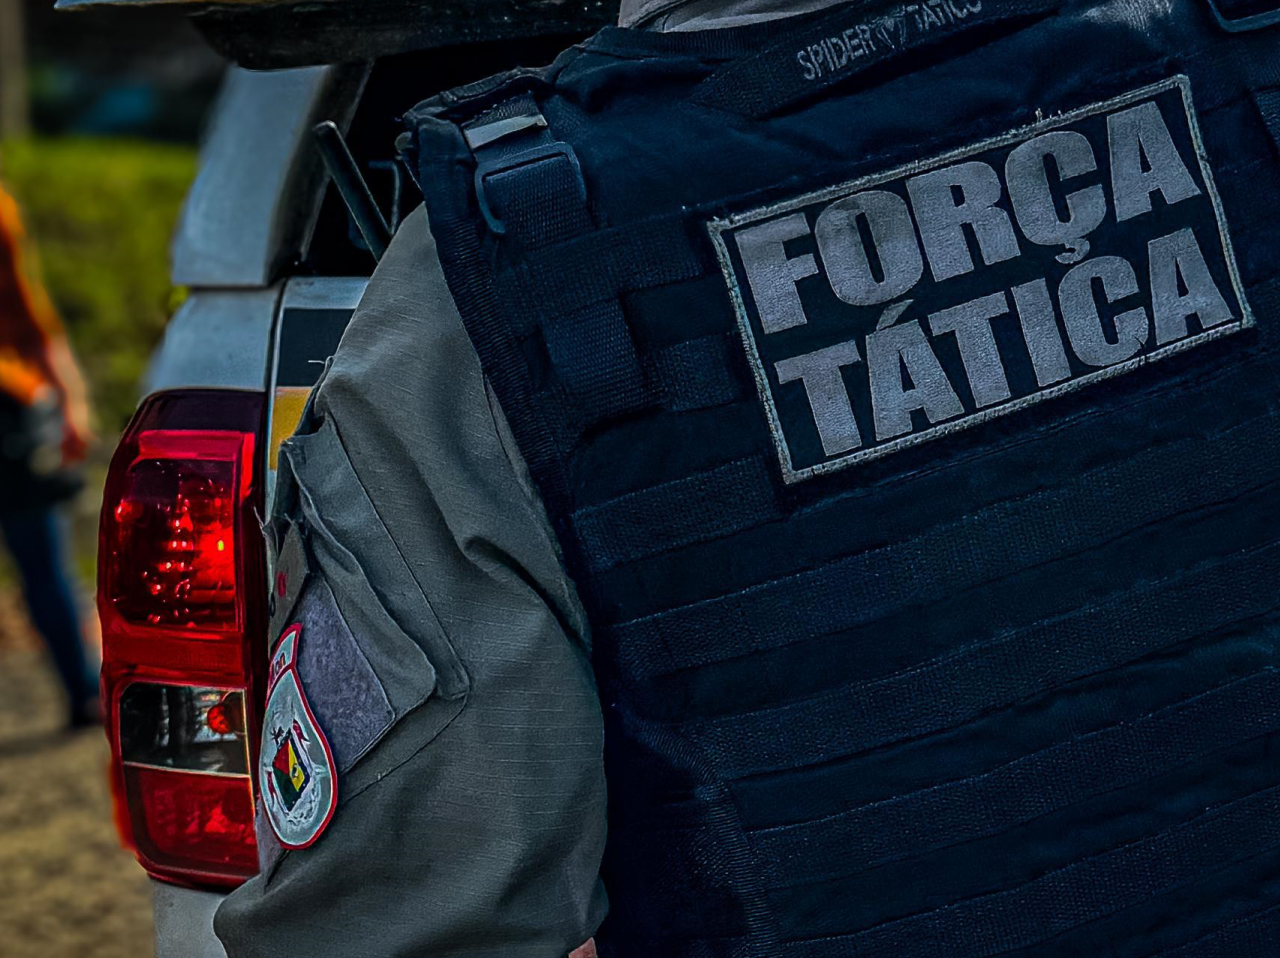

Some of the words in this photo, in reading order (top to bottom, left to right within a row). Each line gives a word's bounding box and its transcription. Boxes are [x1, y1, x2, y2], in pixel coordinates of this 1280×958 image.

[797, 23, 876, 81] SPIDER
[735, 101, 1200, 335] FORÇA
[773, 228, 1235, 457] TÁTICA
